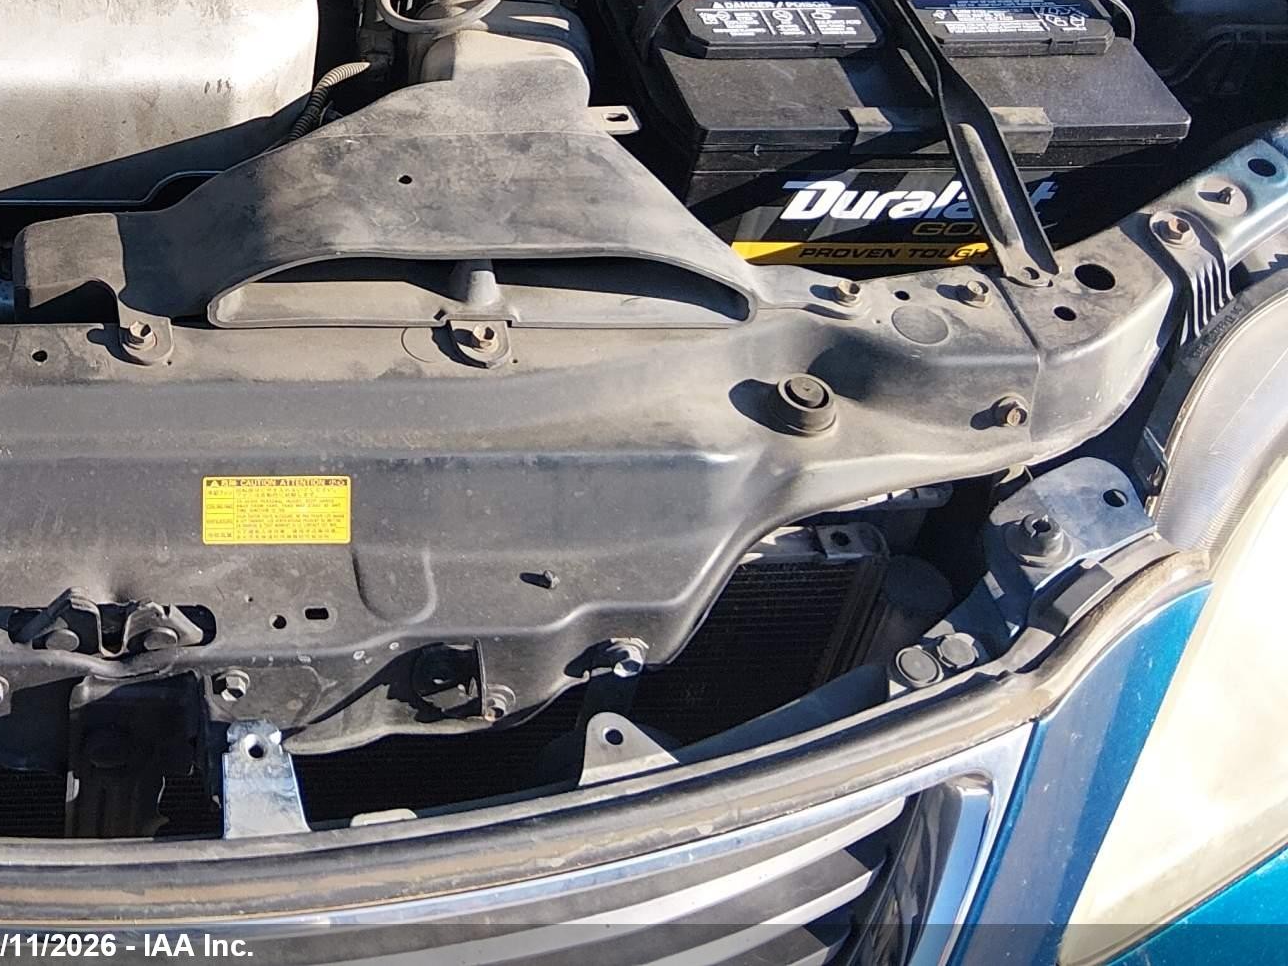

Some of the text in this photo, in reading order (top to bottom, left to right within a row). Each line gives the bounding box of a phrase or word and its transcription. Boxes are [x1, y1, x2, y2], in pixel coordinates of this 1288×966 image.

[781, 181, 1058, 220] Duralat
[799, 248, 901, 259] PROVEN
[239, 479, 276, 487] CAUTION
[279, 479, 327, 487] ATTENTION
